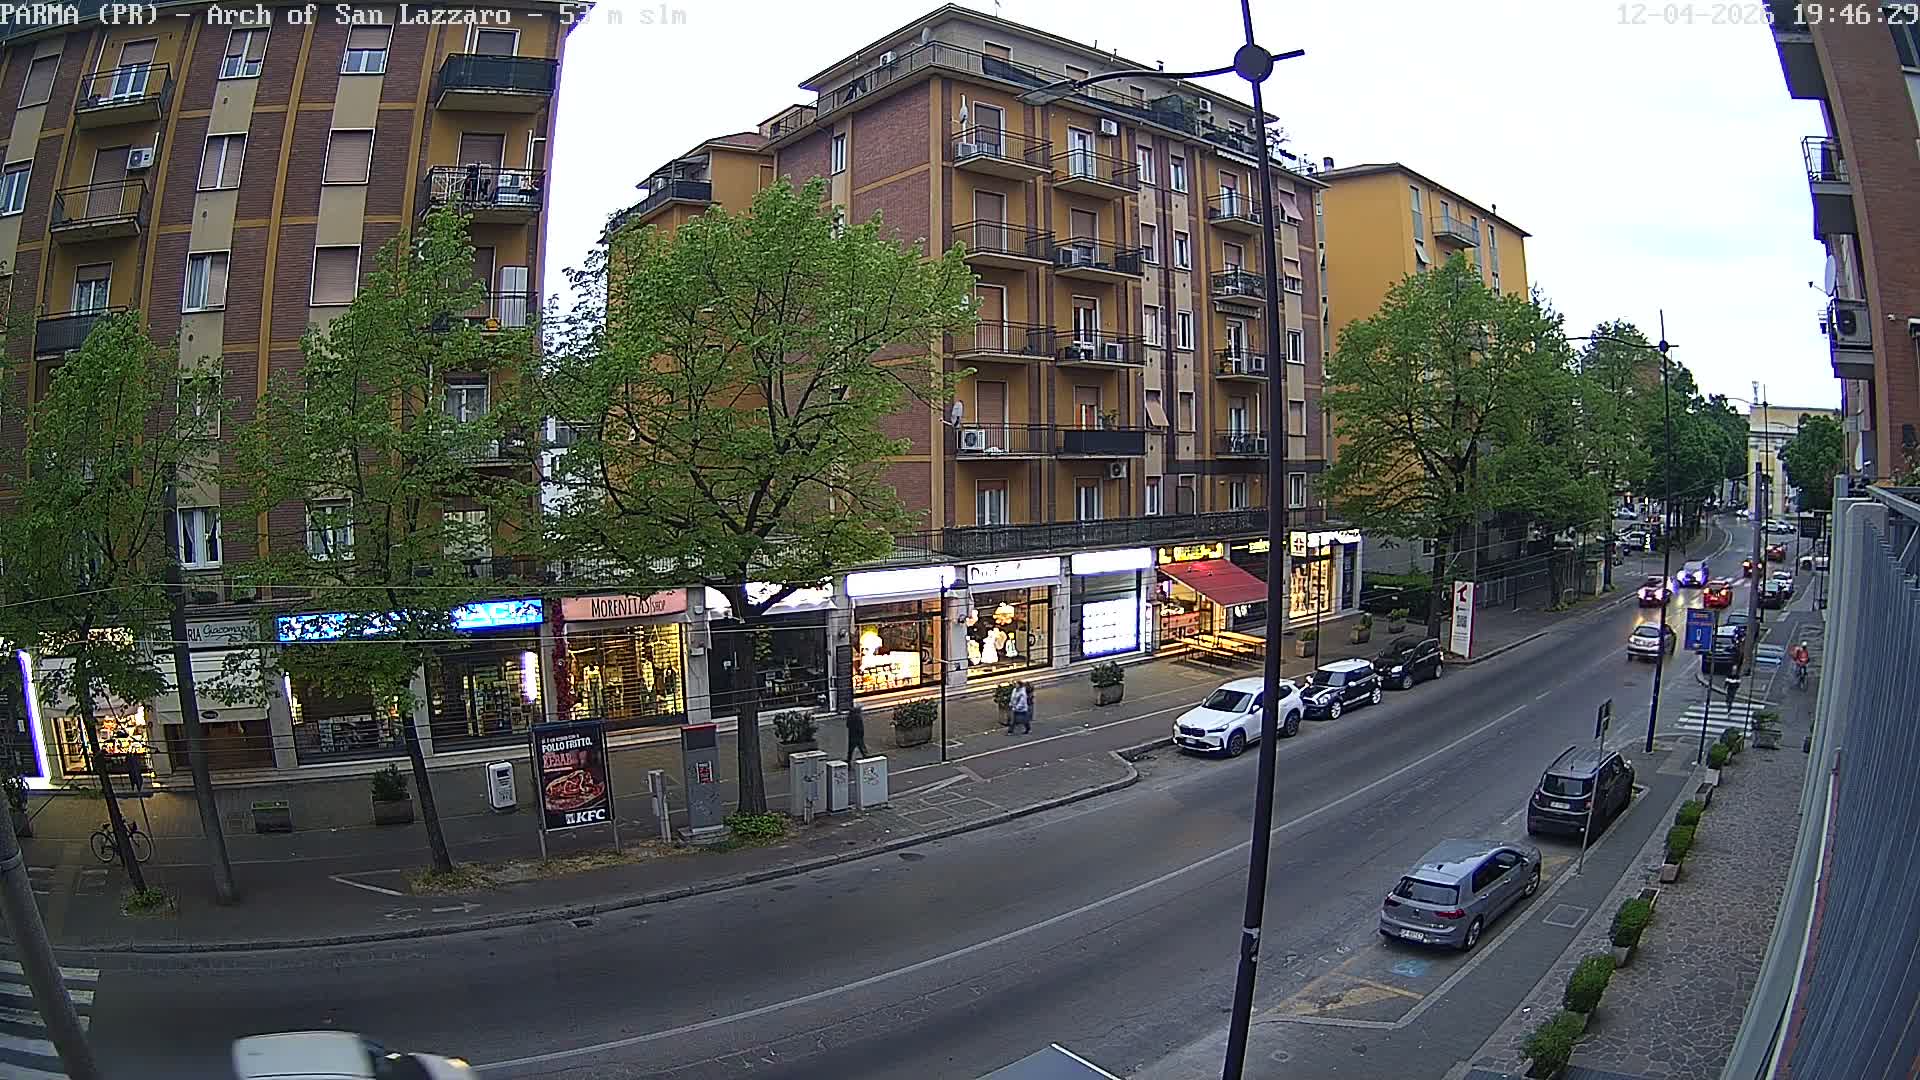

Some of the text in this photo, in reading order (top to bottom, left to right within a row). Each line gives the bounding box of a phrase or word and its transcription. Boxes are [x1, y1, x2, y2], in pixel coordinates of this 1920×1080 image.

[591, 598, 650, 618] MORENITAS
[542, 742, 565, 754] POLLO
[576, 809, 605, 823] KFC
